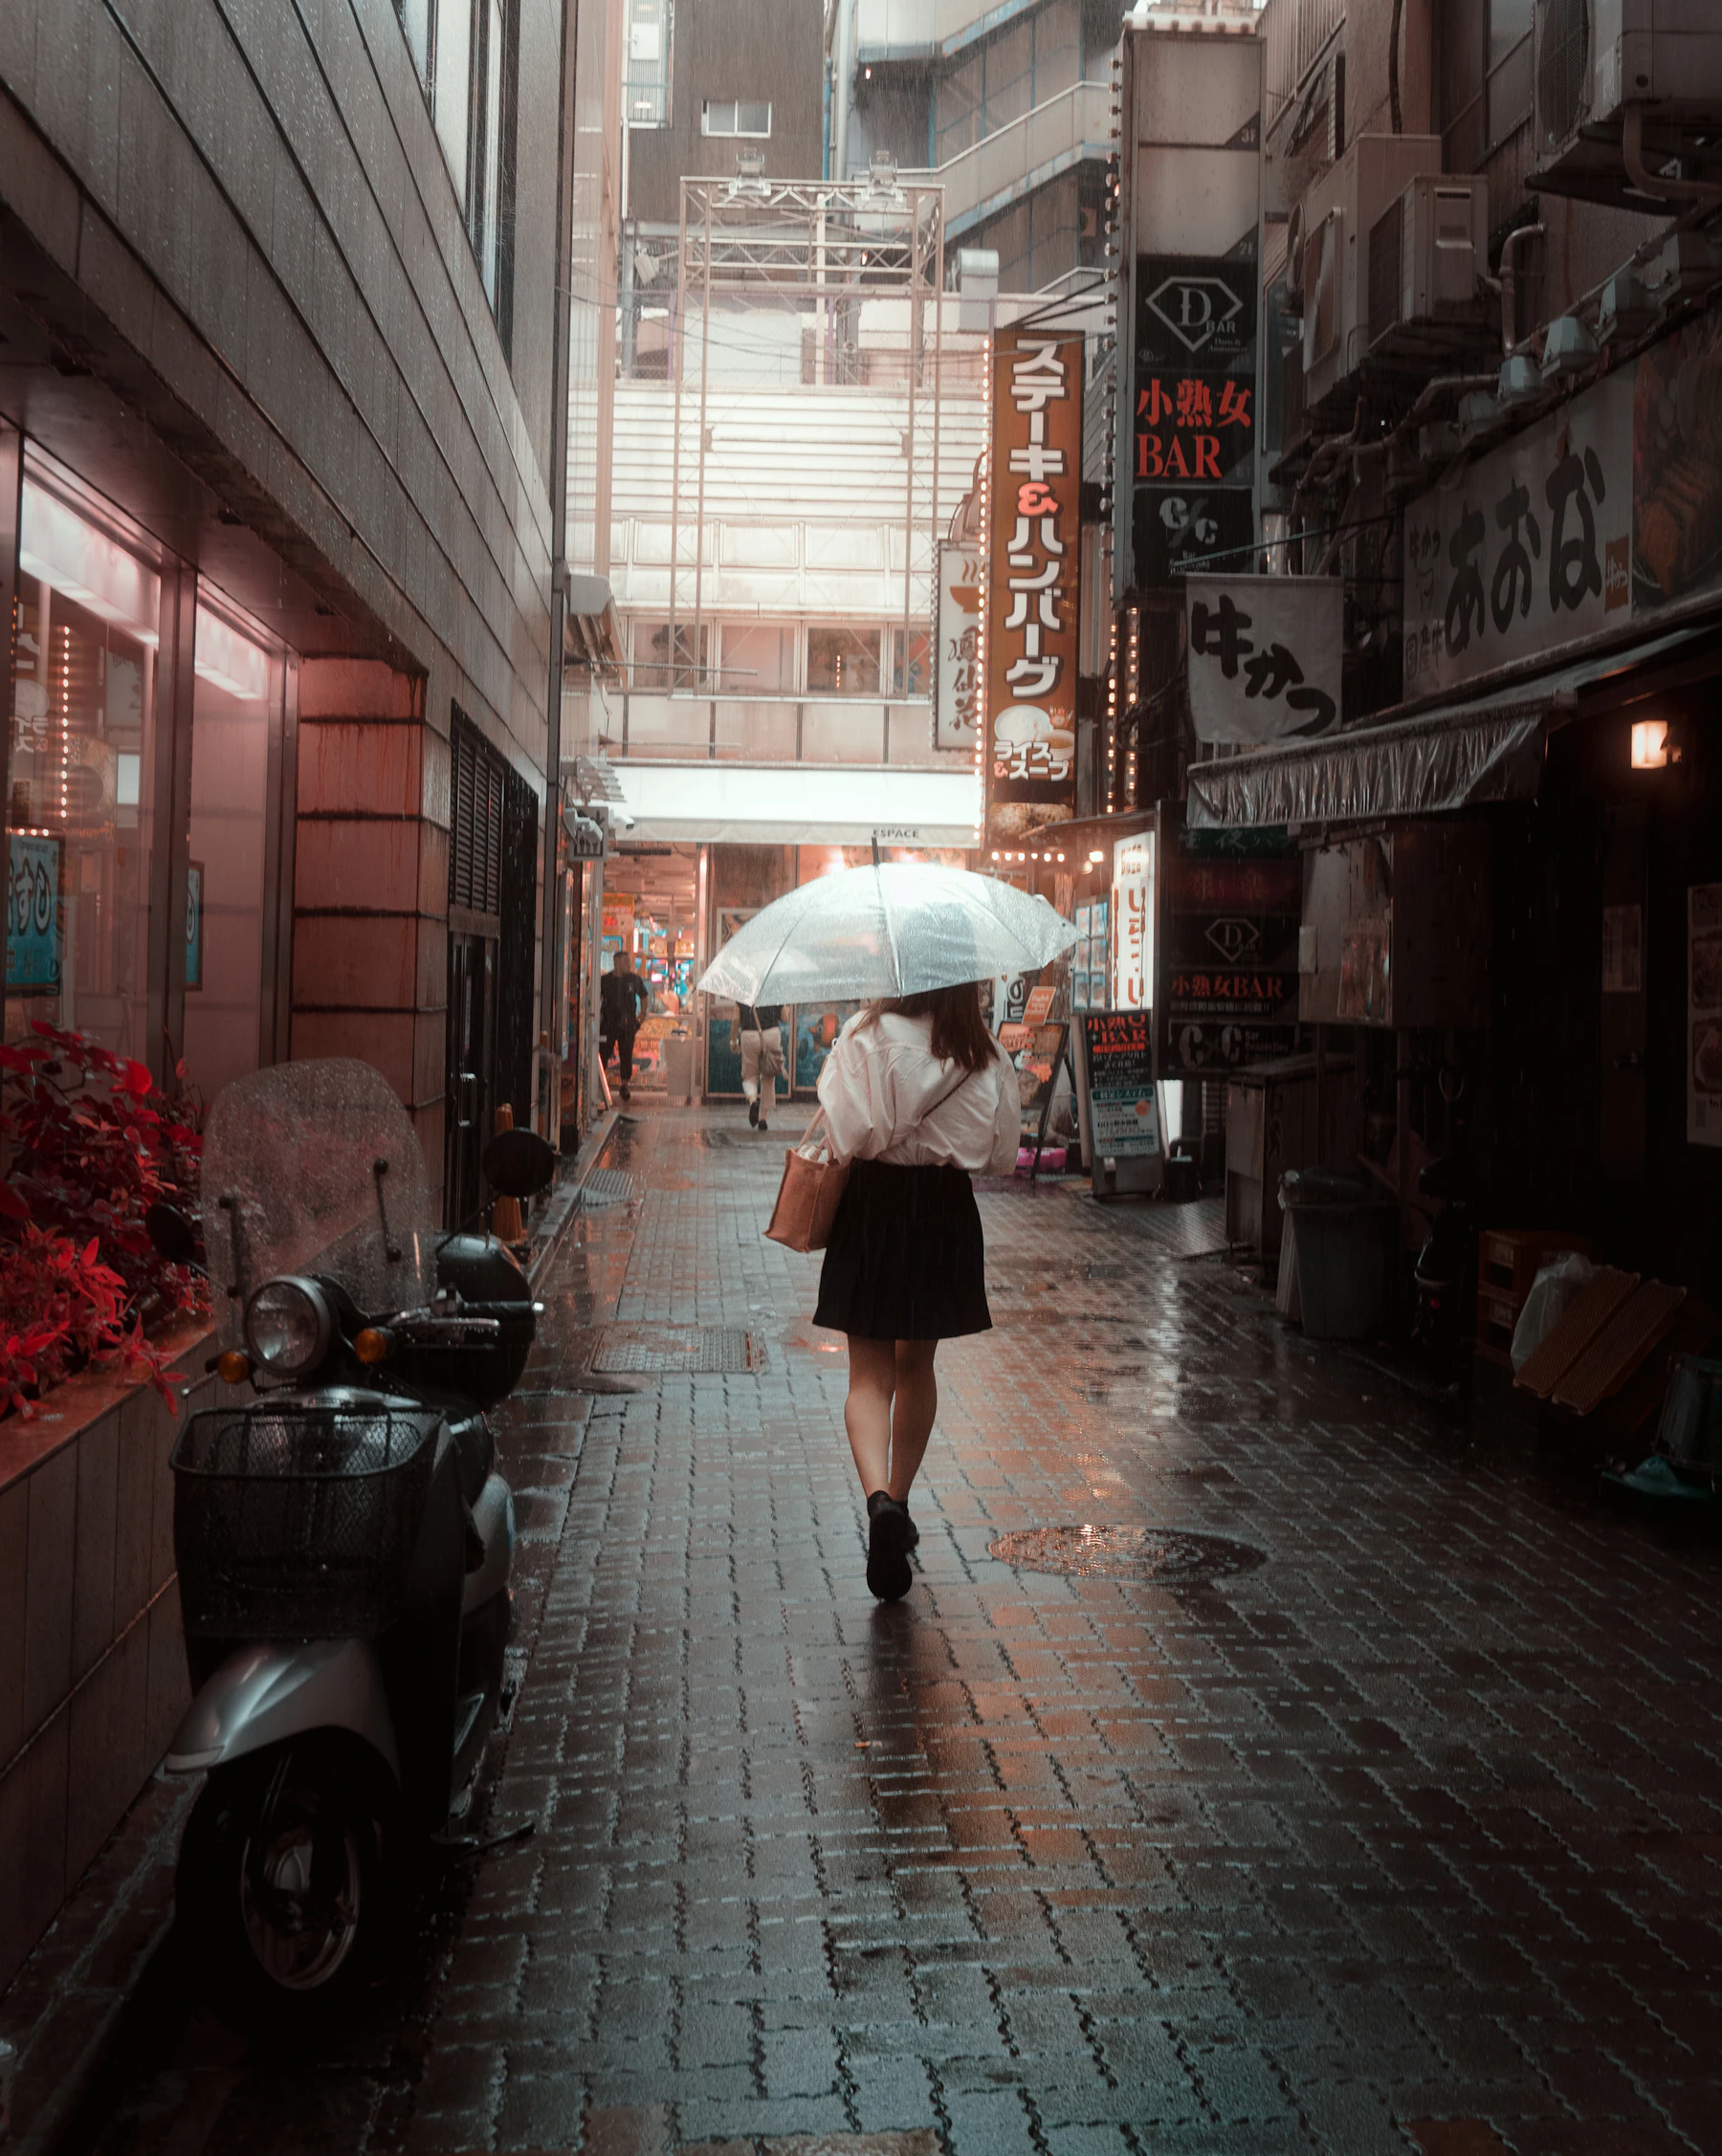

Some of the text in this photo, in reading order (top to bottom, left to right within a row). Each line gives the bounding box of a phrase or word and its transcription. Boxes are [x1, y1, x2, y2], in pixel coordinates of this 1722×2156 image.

[1177, 286, 1211, 327] D
[1206, 319, 1236, 335] BAR
[1137, 377, 1252, 429] 小熟女
[1136, 433, 1224, 479] BAR
[1005, 338, 1068, 699] ステーキ&ハンバーグ
[1191, 594, 1337, 736] 牛かつ
[994, 739, 1052, 761] ライス
[1170, 975, 1284, 1000] 小熟女BAR
